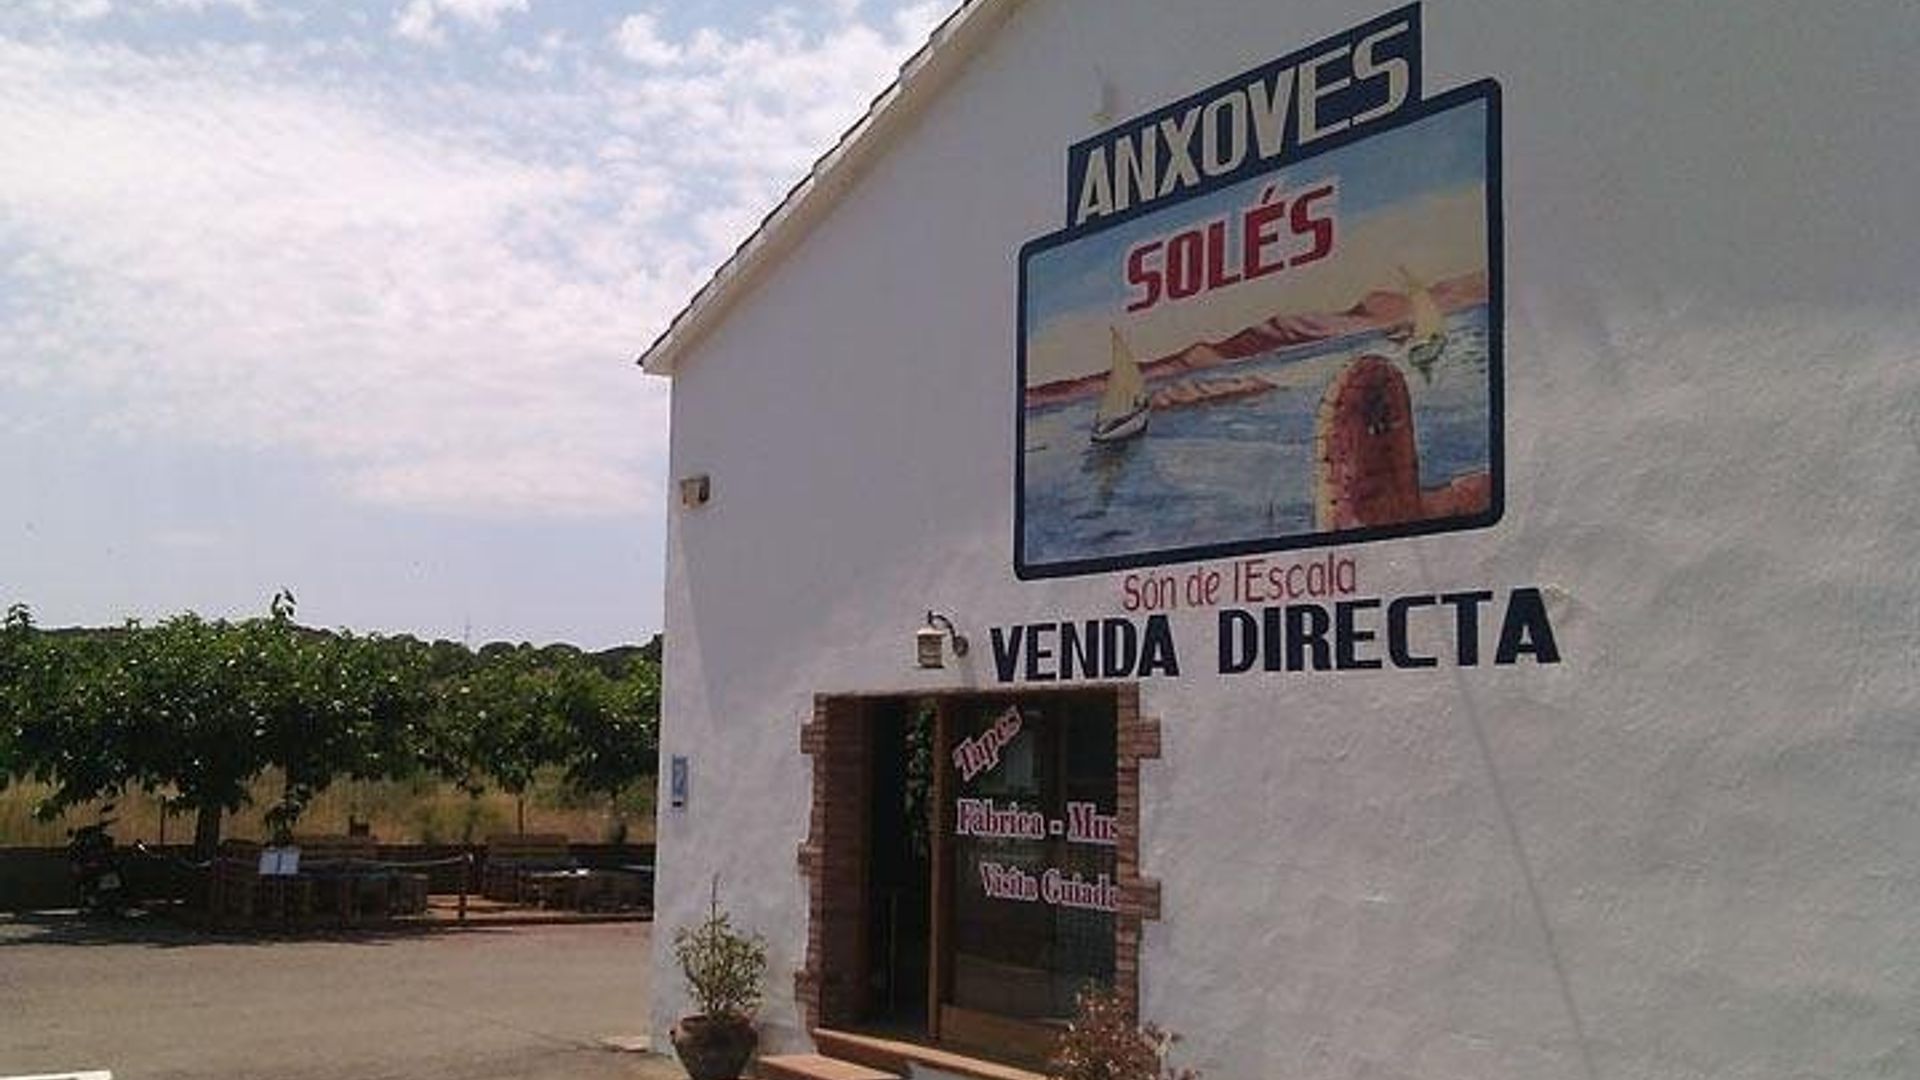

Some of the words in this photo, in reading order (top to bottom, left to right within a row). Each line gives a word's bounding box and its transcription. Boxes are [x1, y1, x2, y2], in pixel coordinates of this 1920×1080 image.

[1076, 20, 1409, 224] ANXOVES
[1126, 185, 1334, 312] SOLÉS
[991, 615, 1180, 682] VENDA
[1218, 587, 1561, 674] DIRECTA
[1186, 565, 1220, 607] de
